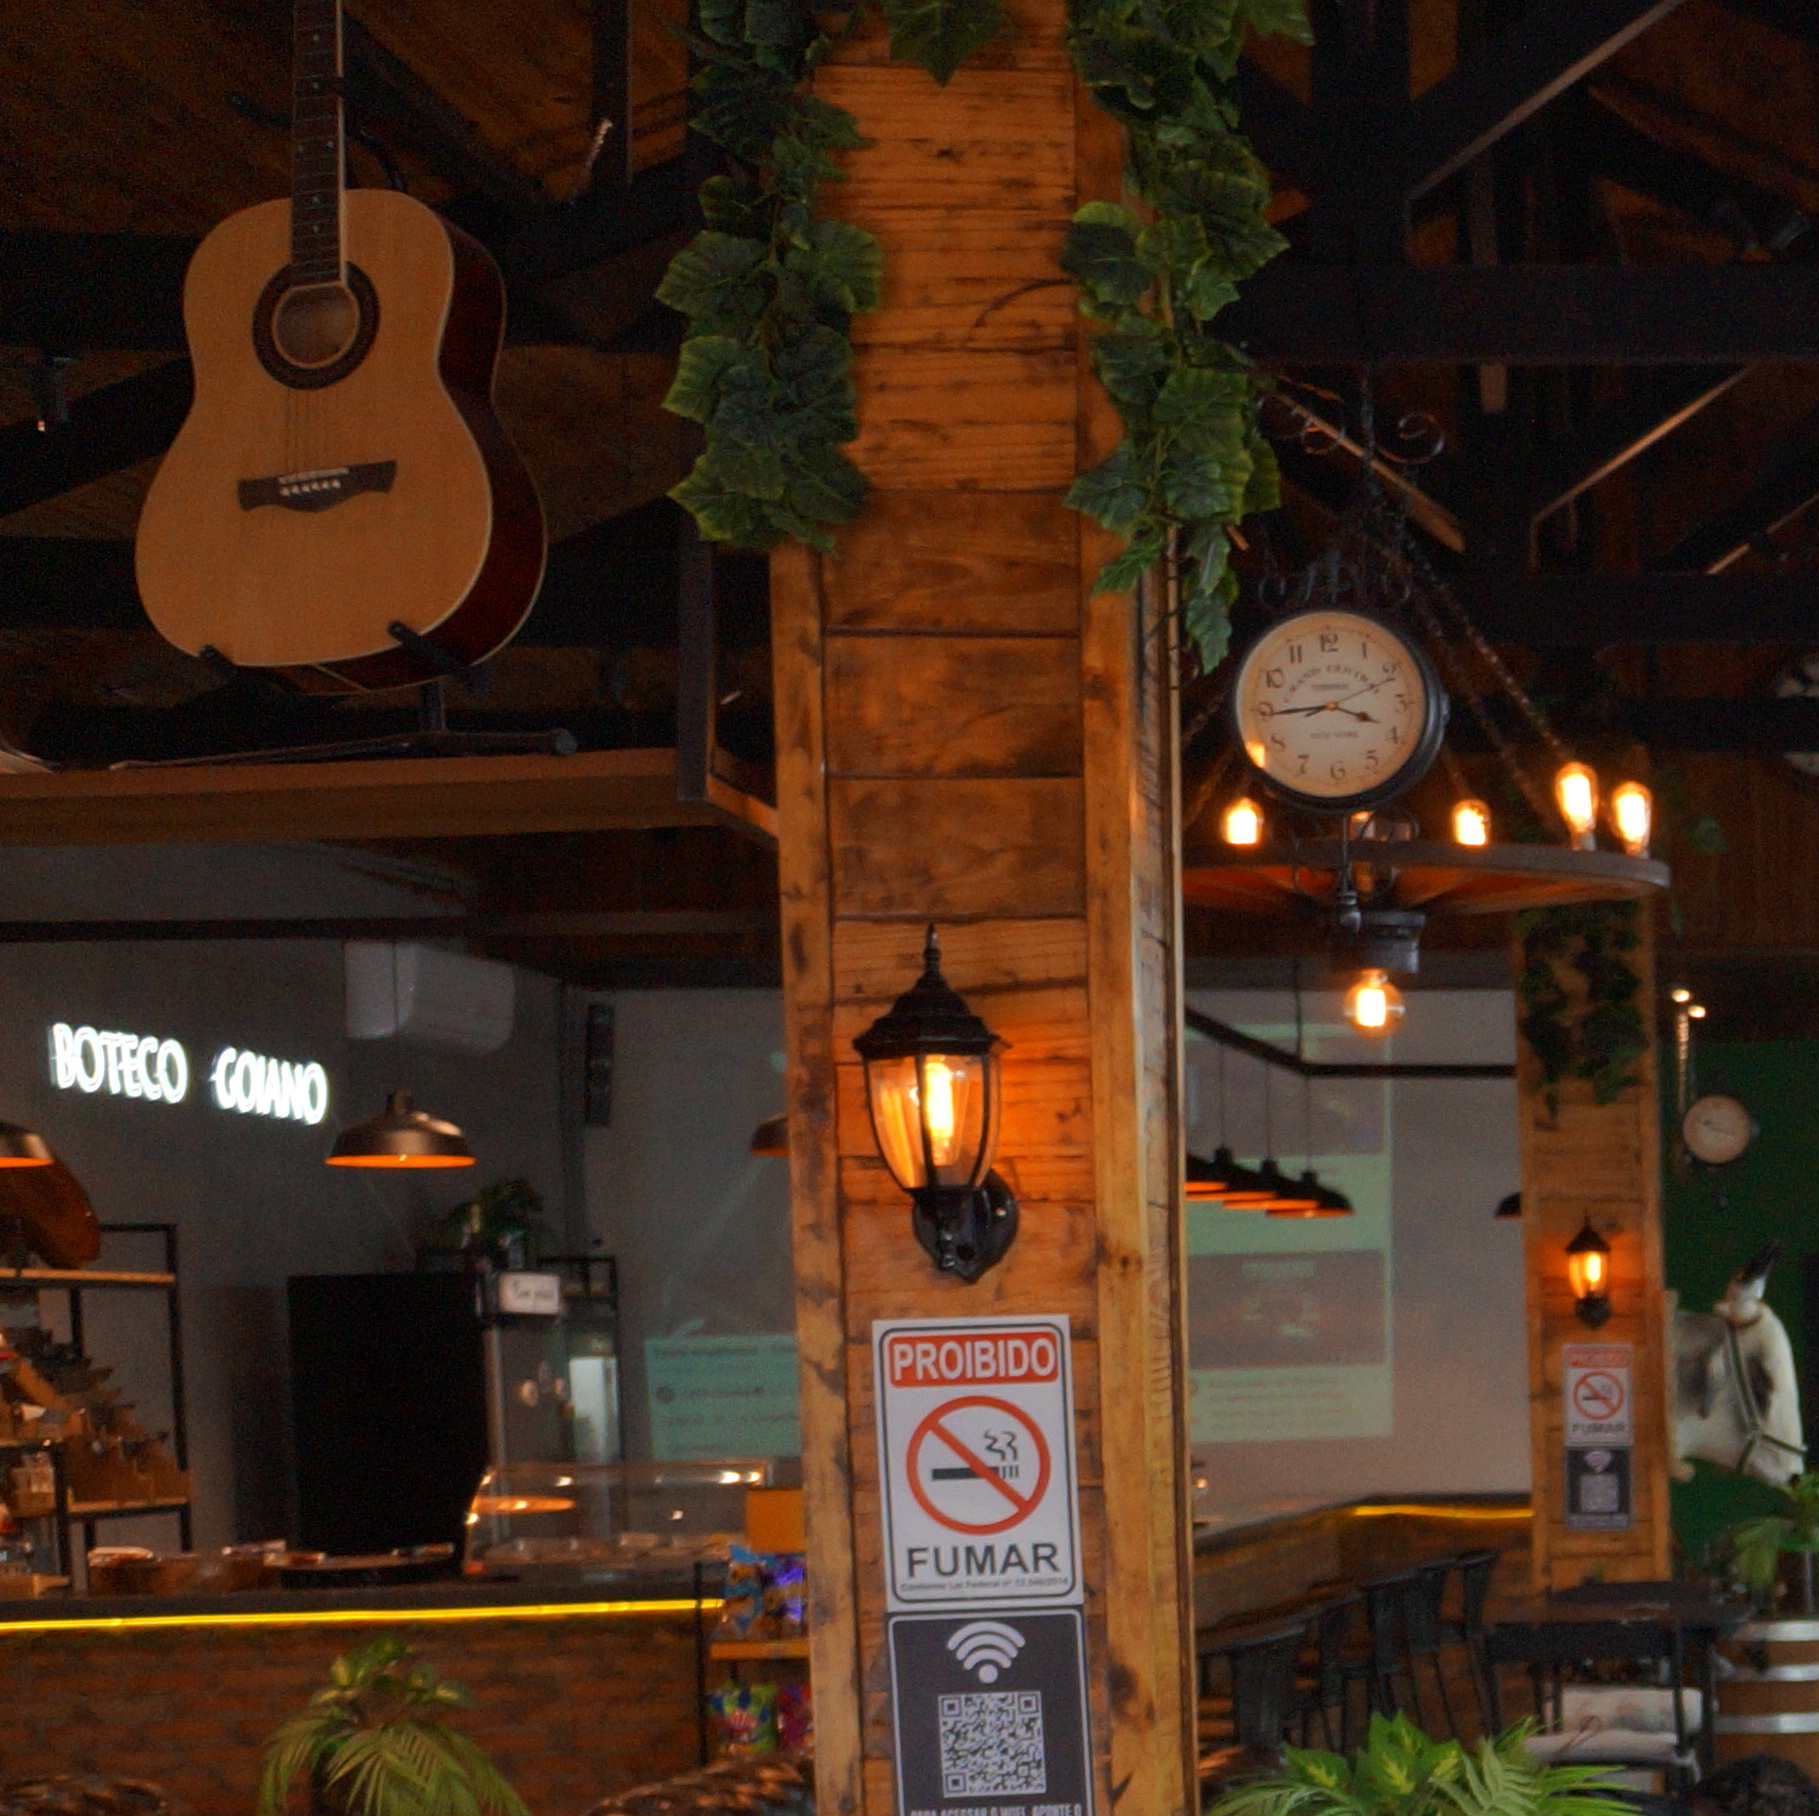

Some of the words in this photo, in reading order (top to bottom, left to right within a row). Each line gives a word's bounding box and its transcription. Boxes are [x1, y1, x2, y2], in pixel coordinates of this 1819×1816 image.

[1319, 633, 1339, 652] 12
[1289, 645, 1303, 664] 11
[1266, 668, 1284, 689] 10
[1297, 754, 1310, 775] 7
[50, 1022, 188, 1104] BOTECO
[209, 1046, 328, 1125] GOIANO
[893, 1338, 1056, 1381] PROIBIDO
[907, 1542, 1061, 1579] FUMAR
